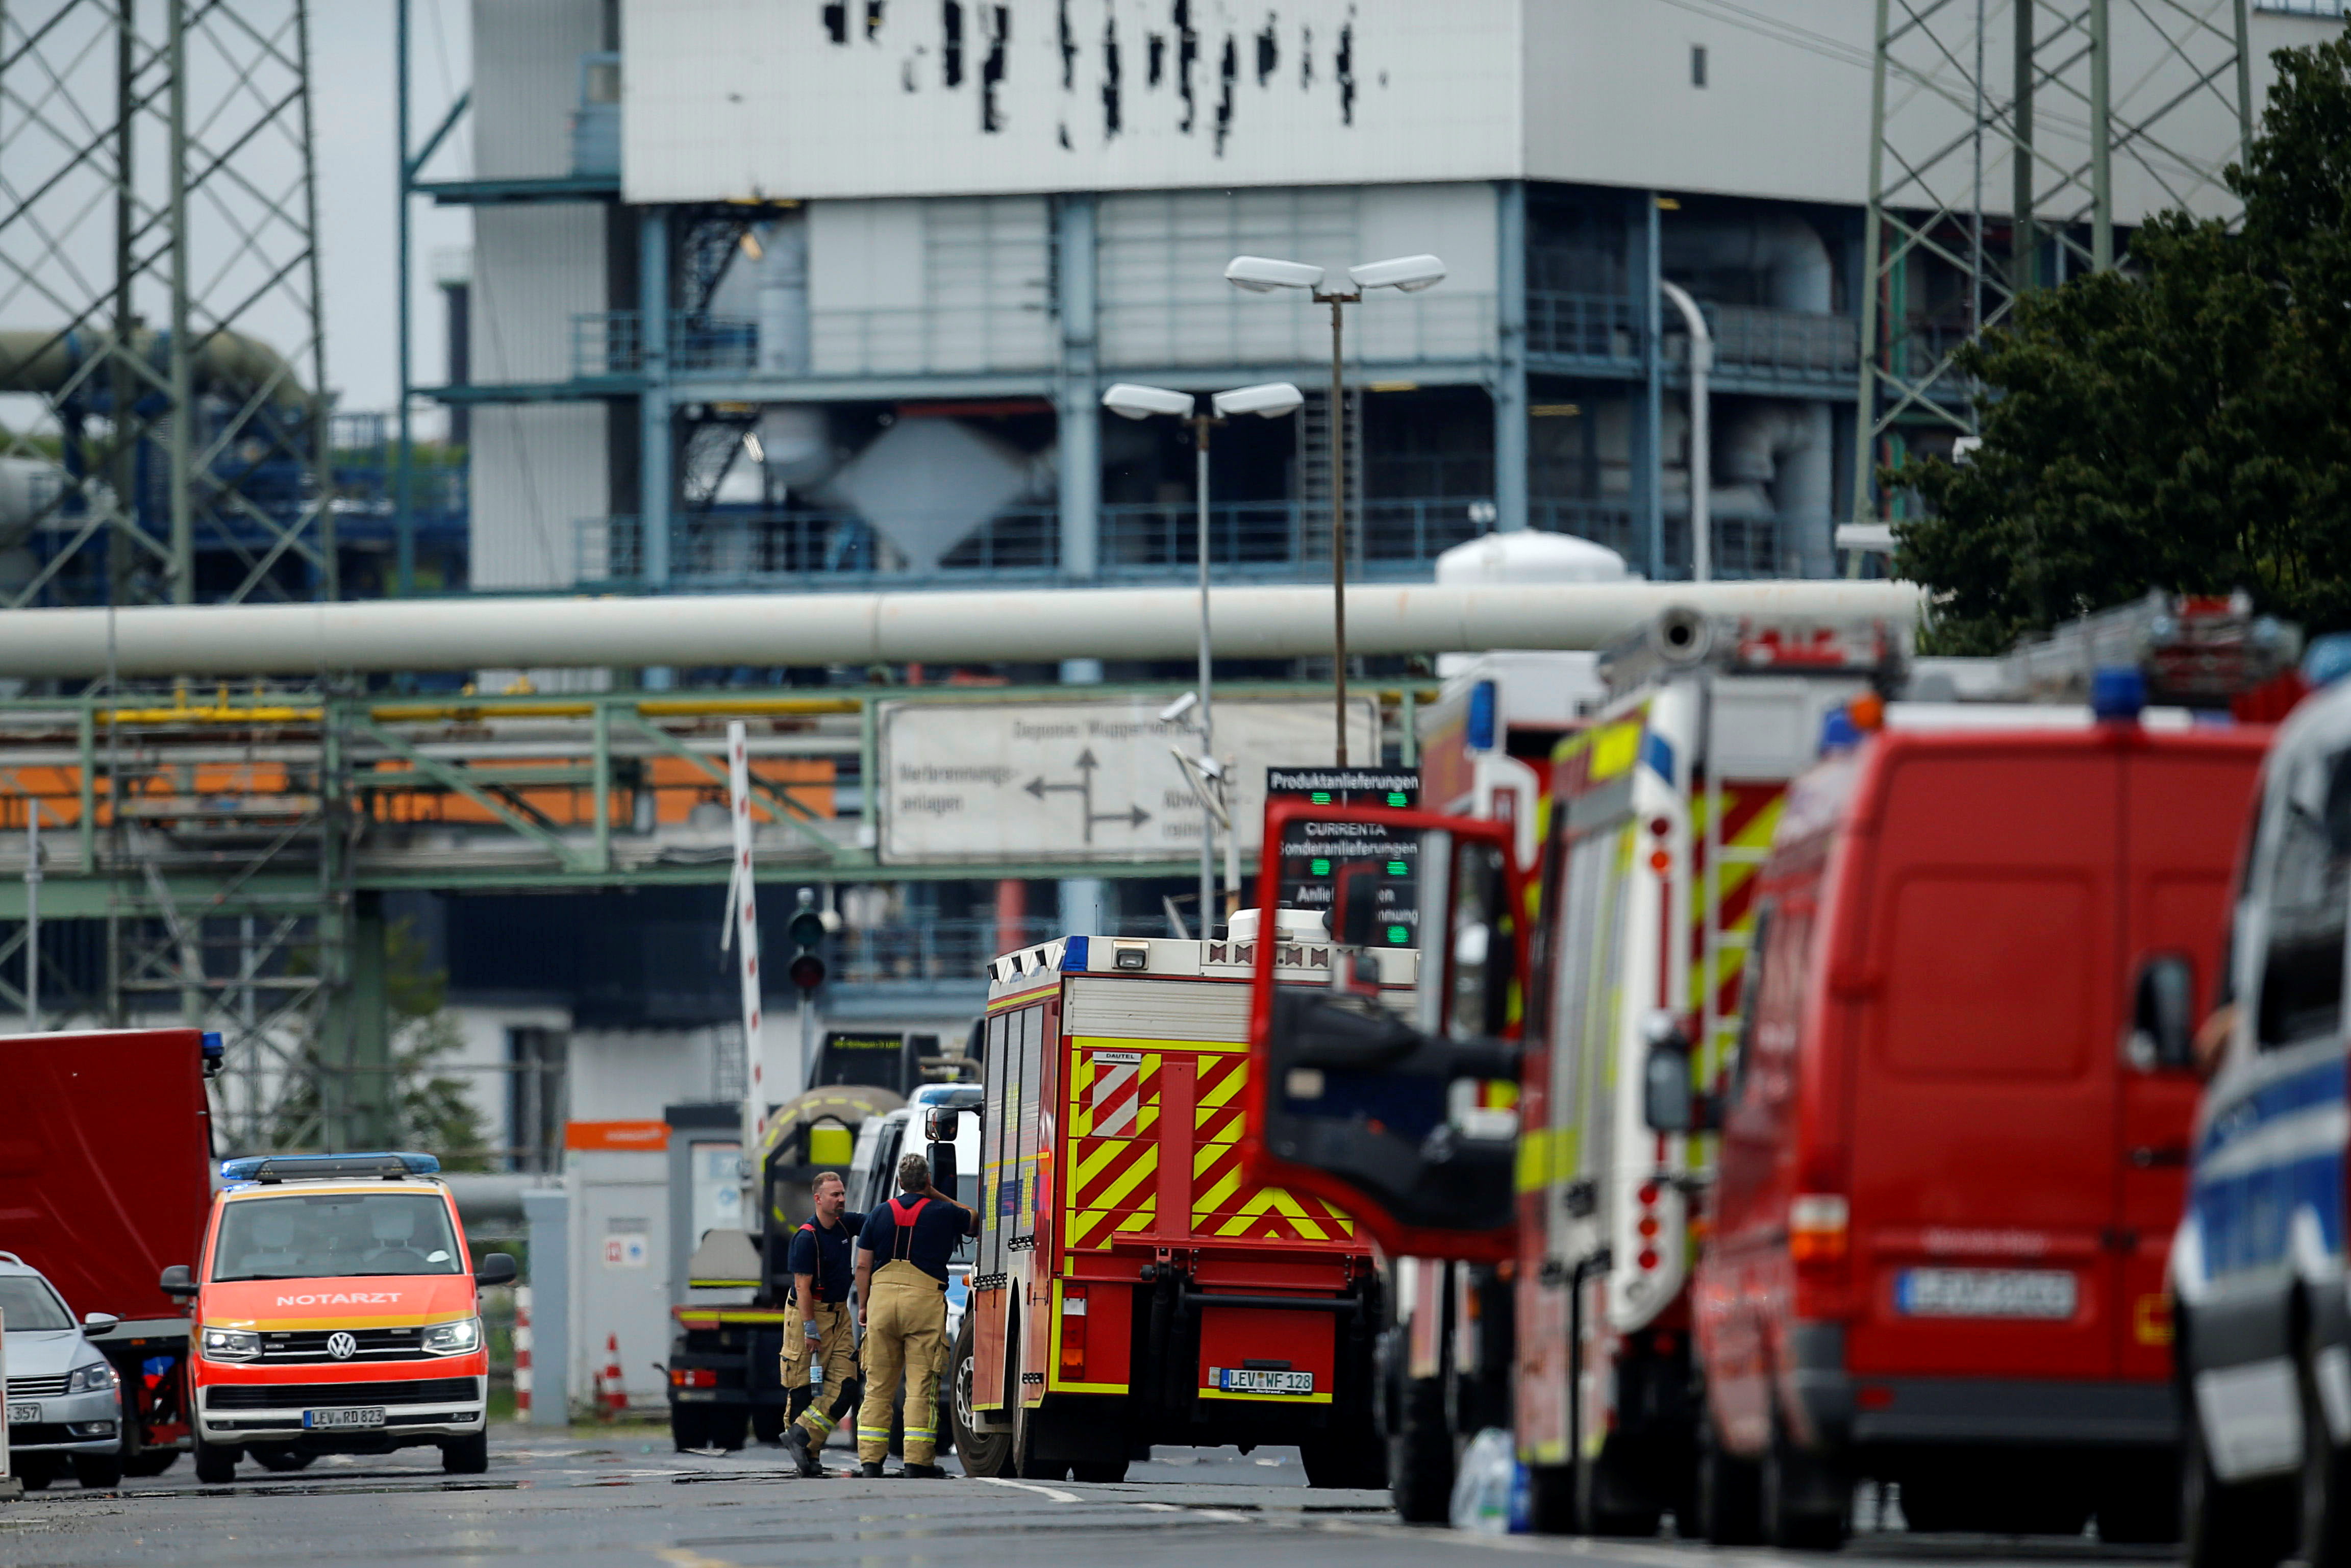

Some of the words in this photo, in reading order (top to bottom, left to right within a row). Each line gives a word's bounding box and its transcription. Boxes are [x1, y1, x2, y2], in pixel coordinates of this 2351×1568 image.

[1271, 771, 1418, 792] Produktanlieferungen
[1305, 823, 1388, 836] CURRENTA
[277, 1293, 403, 1306] NOTARZT
[1230, 1372, 1255, 1386] LEV
[1266, 1373, 1283, 1387] WF
[1287, 1374, 1311, 1389] 128
[14, 1406, 38, 1420] 357
[313, 1411, 334, 1424] LEV
[344, 1411, 358, 1423] RD
[361, 1410, 382, 1423] 823
